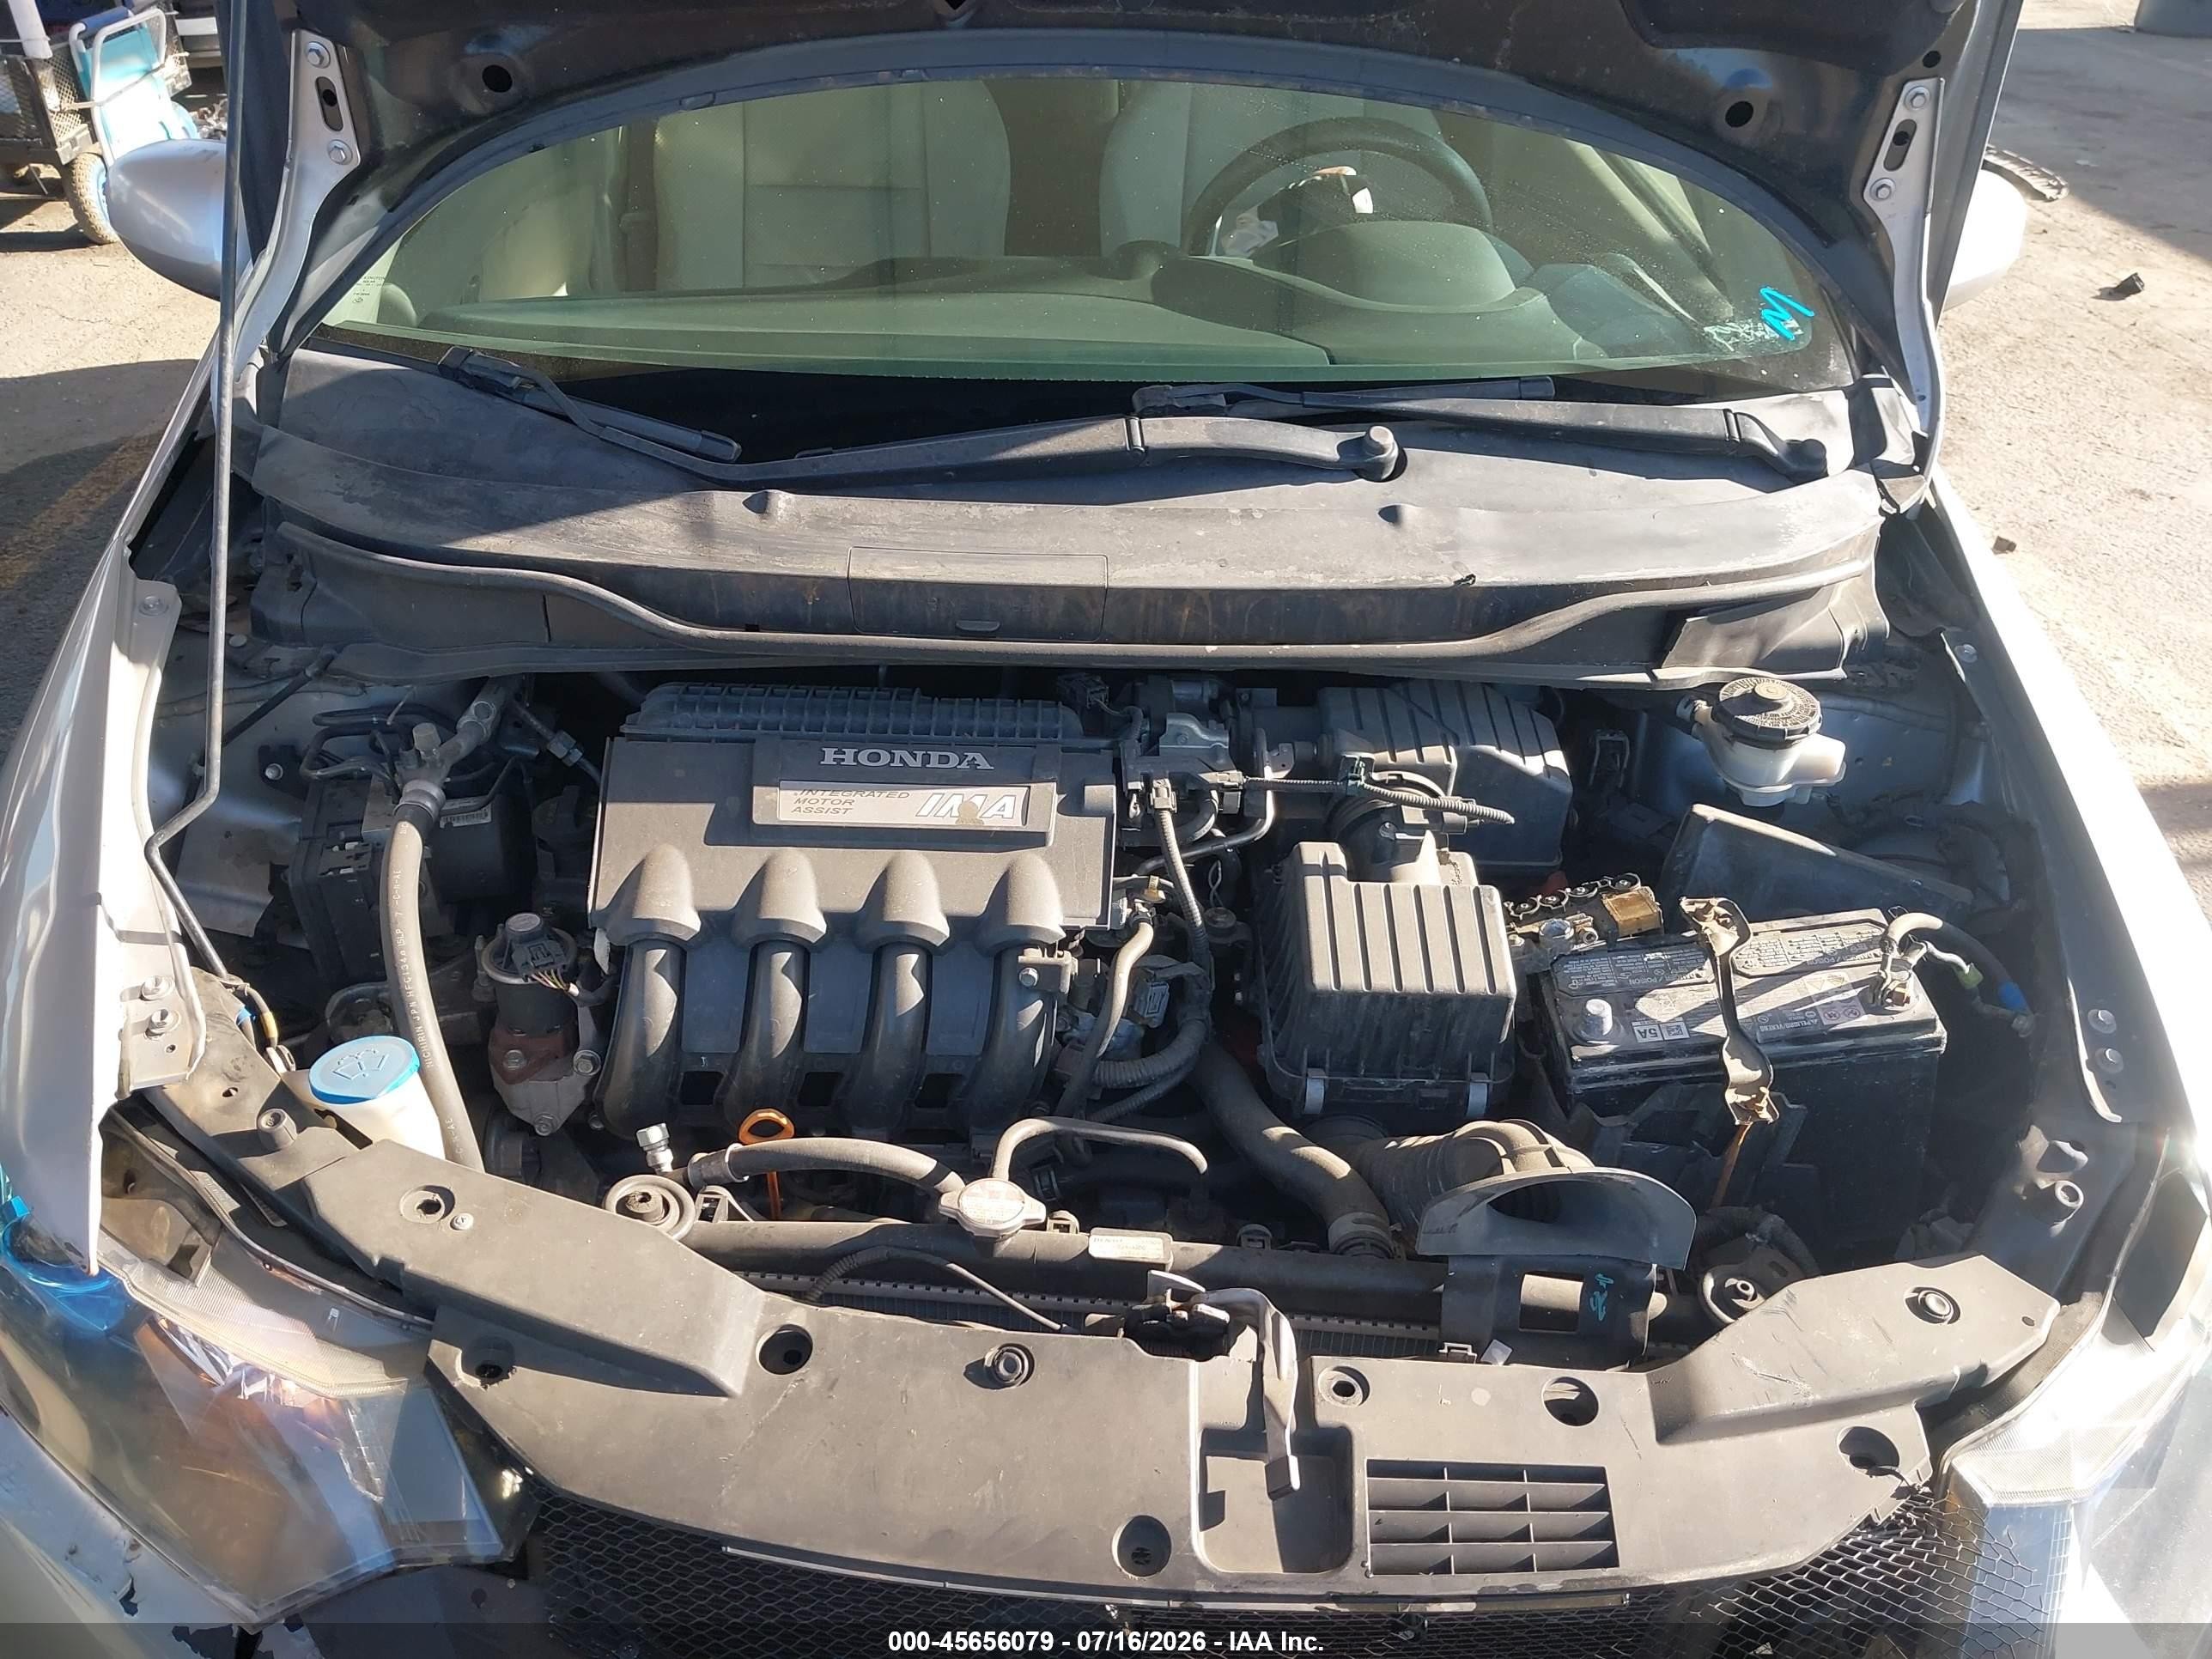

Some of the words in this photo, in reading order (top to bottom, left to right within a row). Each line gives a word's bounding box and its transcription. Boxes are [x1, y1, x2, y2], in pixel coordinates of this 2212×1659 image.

[820, 747, 995, 770] HONDA
[799, 789, 910, 799] INTEGRATED
[791, 806, 854, 815] ASSIST
[915, 792, 1018, 819] IMA
[407, 1000, 421, 1022] JPN
[1637, 1028, 1659, 1039] 5A
[415, 1025, 434, 1067] NICHIRIN
